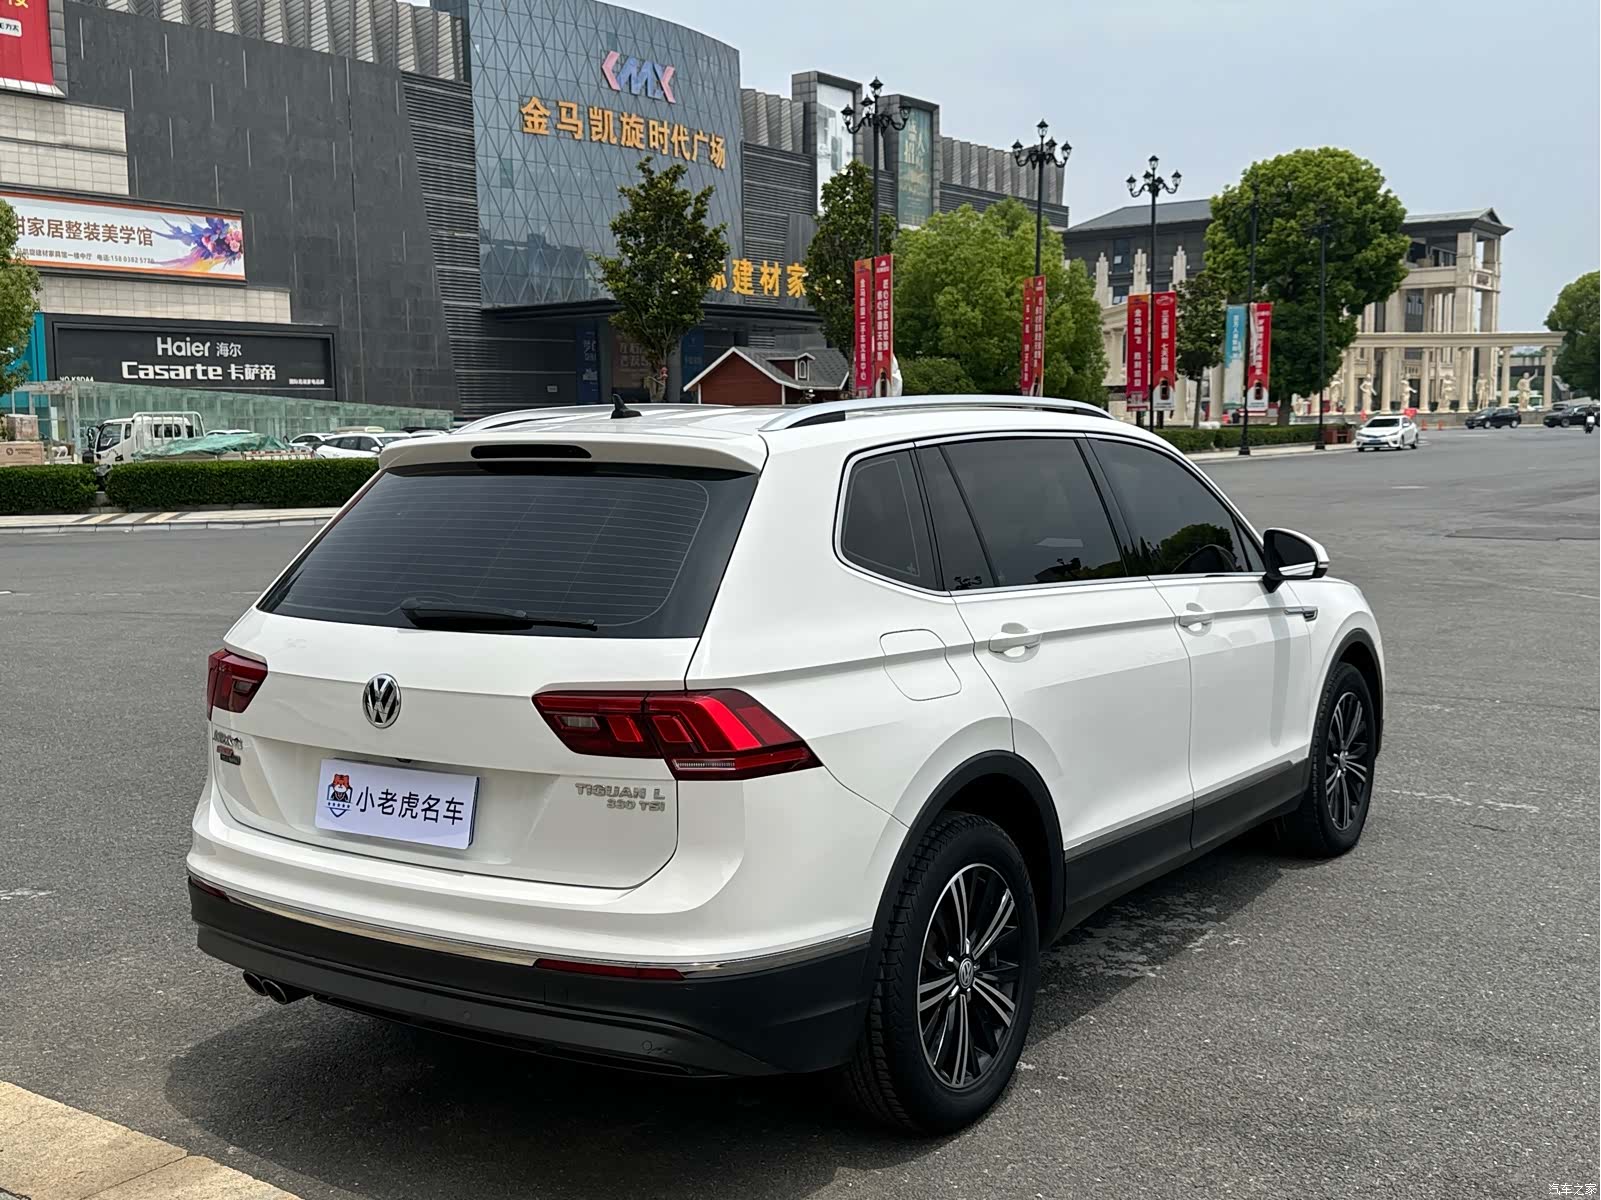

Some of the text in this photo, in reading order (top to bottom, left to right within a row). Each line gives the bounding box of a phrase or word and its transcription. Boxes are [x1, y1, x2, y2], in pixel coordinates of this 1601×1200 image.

[520, 96, 726, 170] 金马凯旋时代广场
[156, 336, 242, 358] Haier 海尔
[121, 361, 276, 381] Casarte 卡萨帝
[575, 782, 666, 800] TIGUAN L
[355, 786, 465, 826] 小老虎名车
[606, 798, 666, 812] 330 TSI
